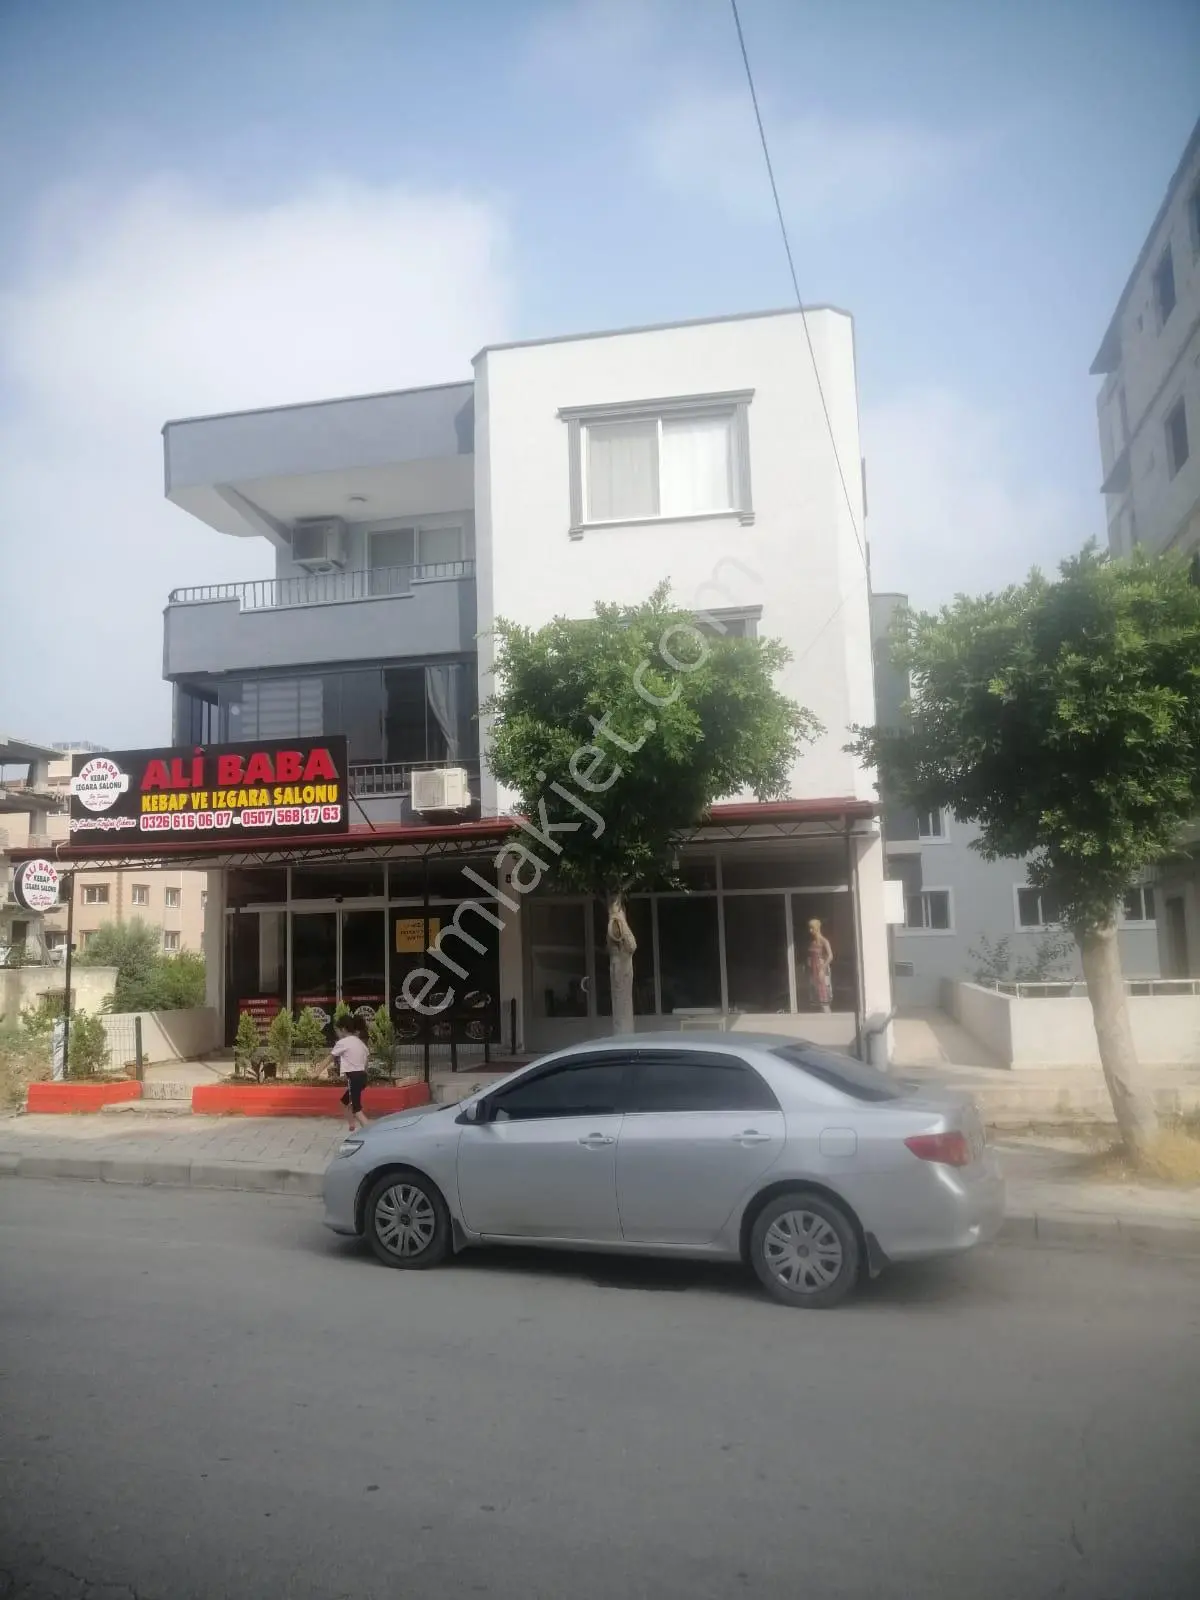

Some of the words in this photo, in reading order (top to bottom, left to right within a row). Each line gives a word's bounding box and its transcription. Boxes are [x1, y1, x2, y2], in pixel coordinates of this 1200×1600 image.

[97, 762, 118, 779] BABA
[140, 745, 205, 791] ALİ
[217, 748, 340, 786] BABA
[91, 774, 108, 782] KEBAP
[99, 782, 122, 790] SALONU
[141, 793, 187, 813] KEBAP
[190, 792, 209, 809] VE
[212, 788, 270, 808] IZGARA
[273, 784, 338, 805] SALONU
[141, 814, 171, 830] 0326
[173, 813, 195, 829] 616
[198, 812, 213, 828] 06
[216, 811, 232, 827] 07
[242, 810, 273, 826] 0507
[277, 808, 300, 824] 568
[303, 807, 319, 823] 17
[322, 806, 340, 822] 63
[34, 875, 51, 883] KEBAP
